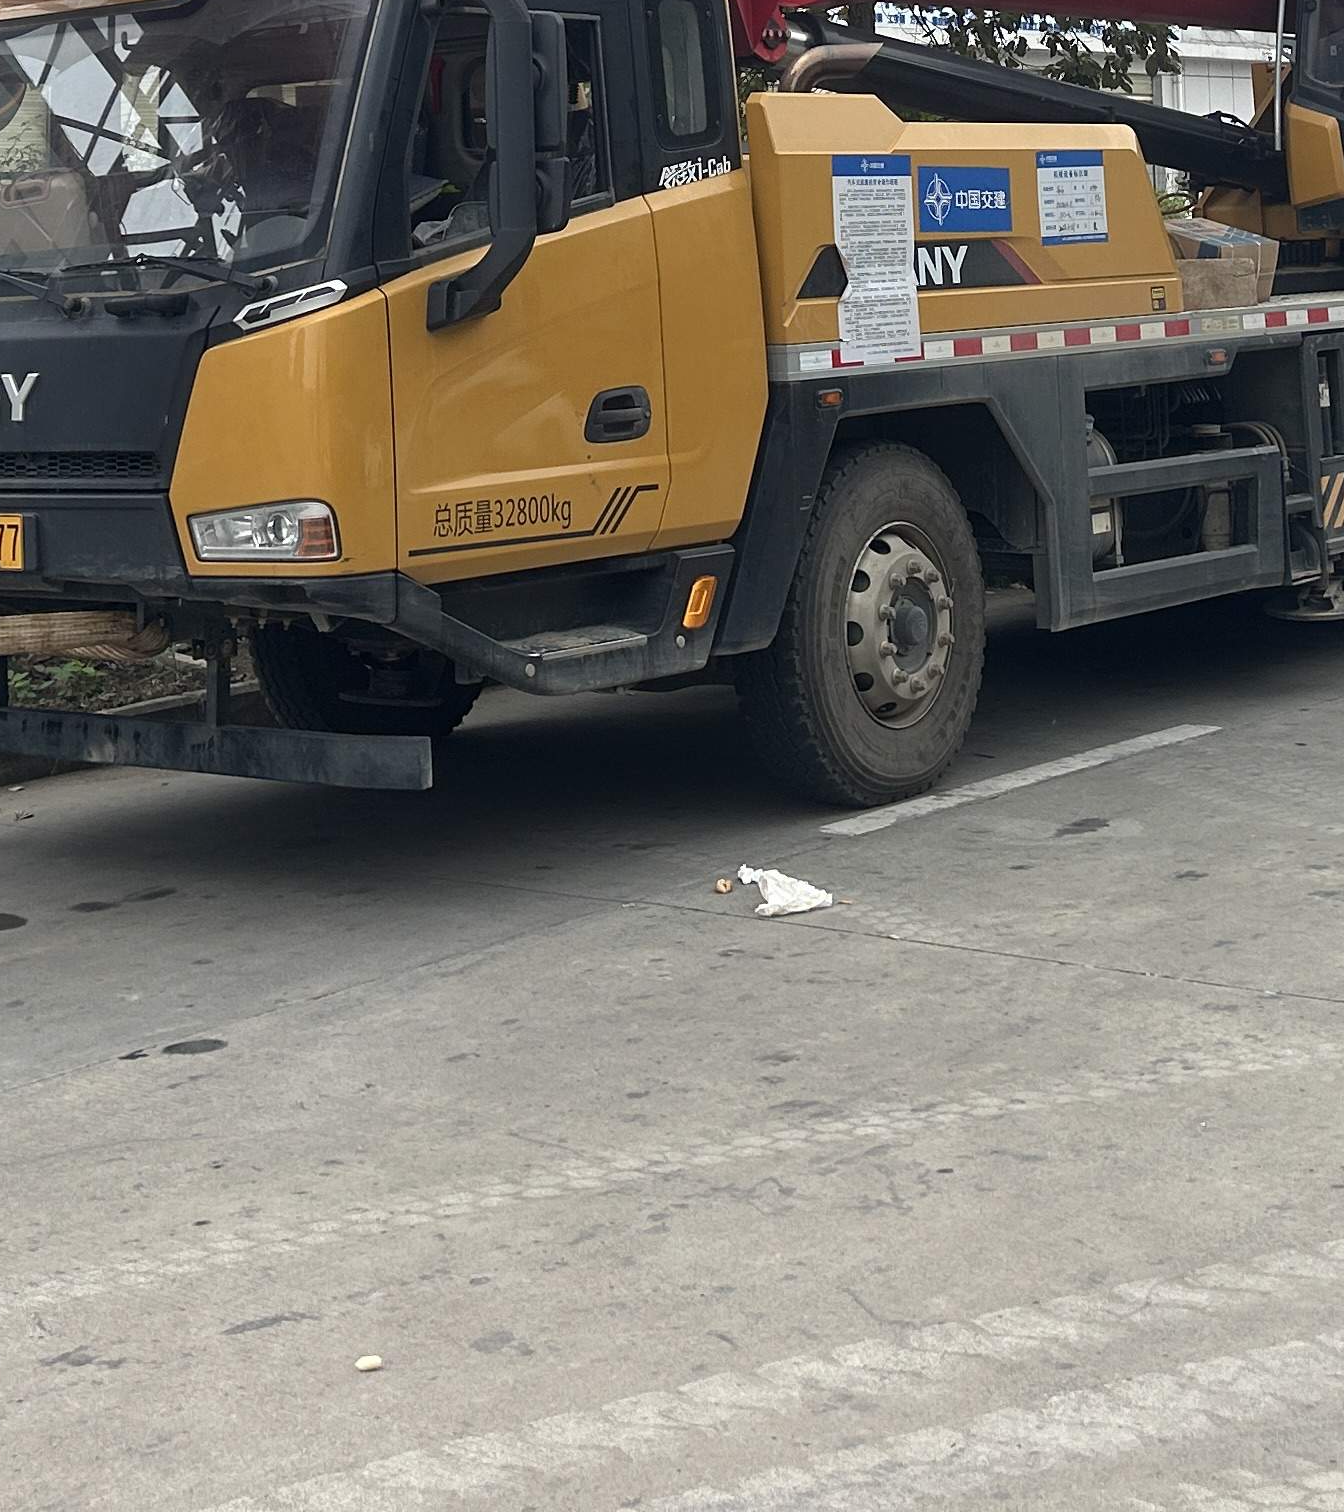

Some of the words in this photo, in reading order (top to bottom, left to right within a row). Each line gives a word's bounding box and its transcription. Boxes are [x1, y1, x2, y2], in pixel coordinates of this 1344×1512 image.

[955, 189, 1007, 210] 中国交建
[433, 493, 572, 537] 总质量32800kg
